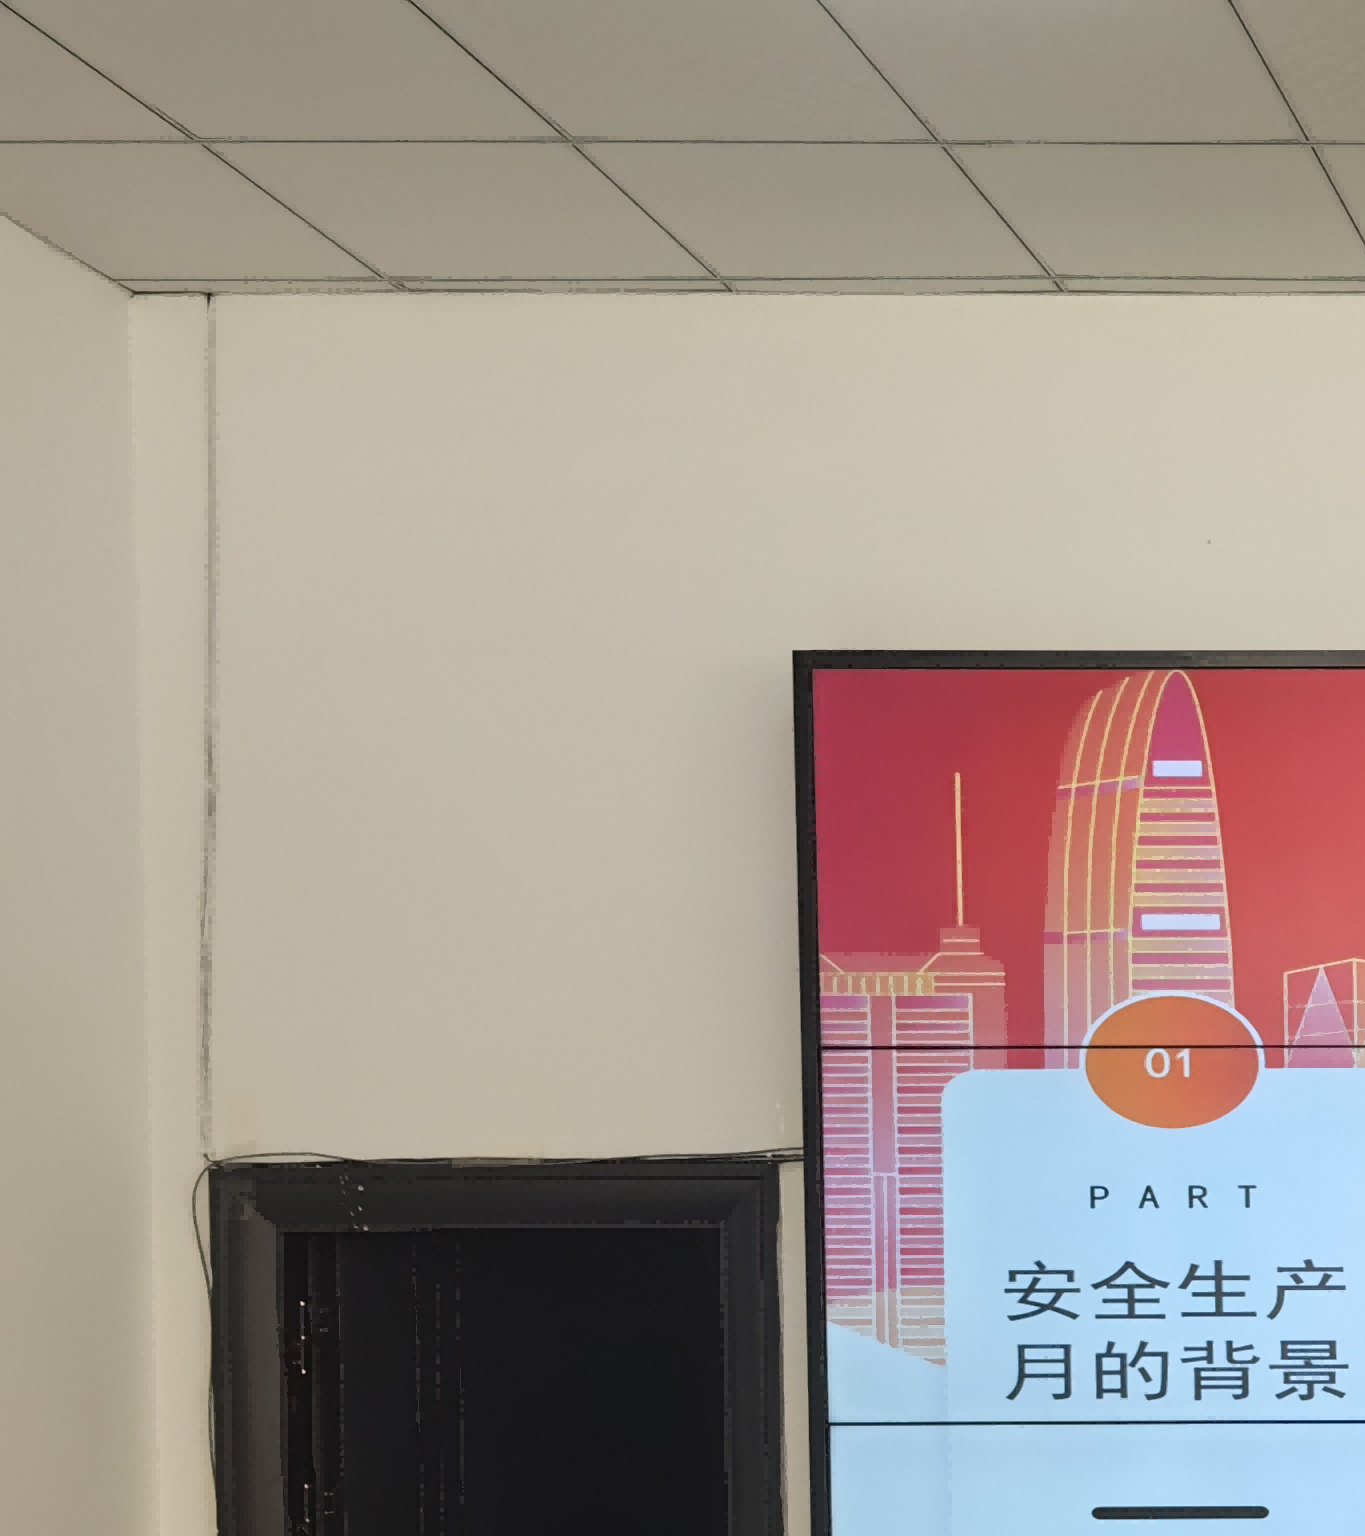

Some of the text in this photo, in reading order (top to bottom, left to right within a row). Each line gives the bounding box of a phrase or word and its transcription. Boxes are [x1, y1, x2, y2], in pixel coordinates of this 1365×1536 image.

[1145, 1048, 1192, 1079] 01
[1090, 1185, 1258, 1209] PART
[1003, 1259, 1347, 1322] 安全生产
[1006, 1340, 1350, 1401] 月的背景
